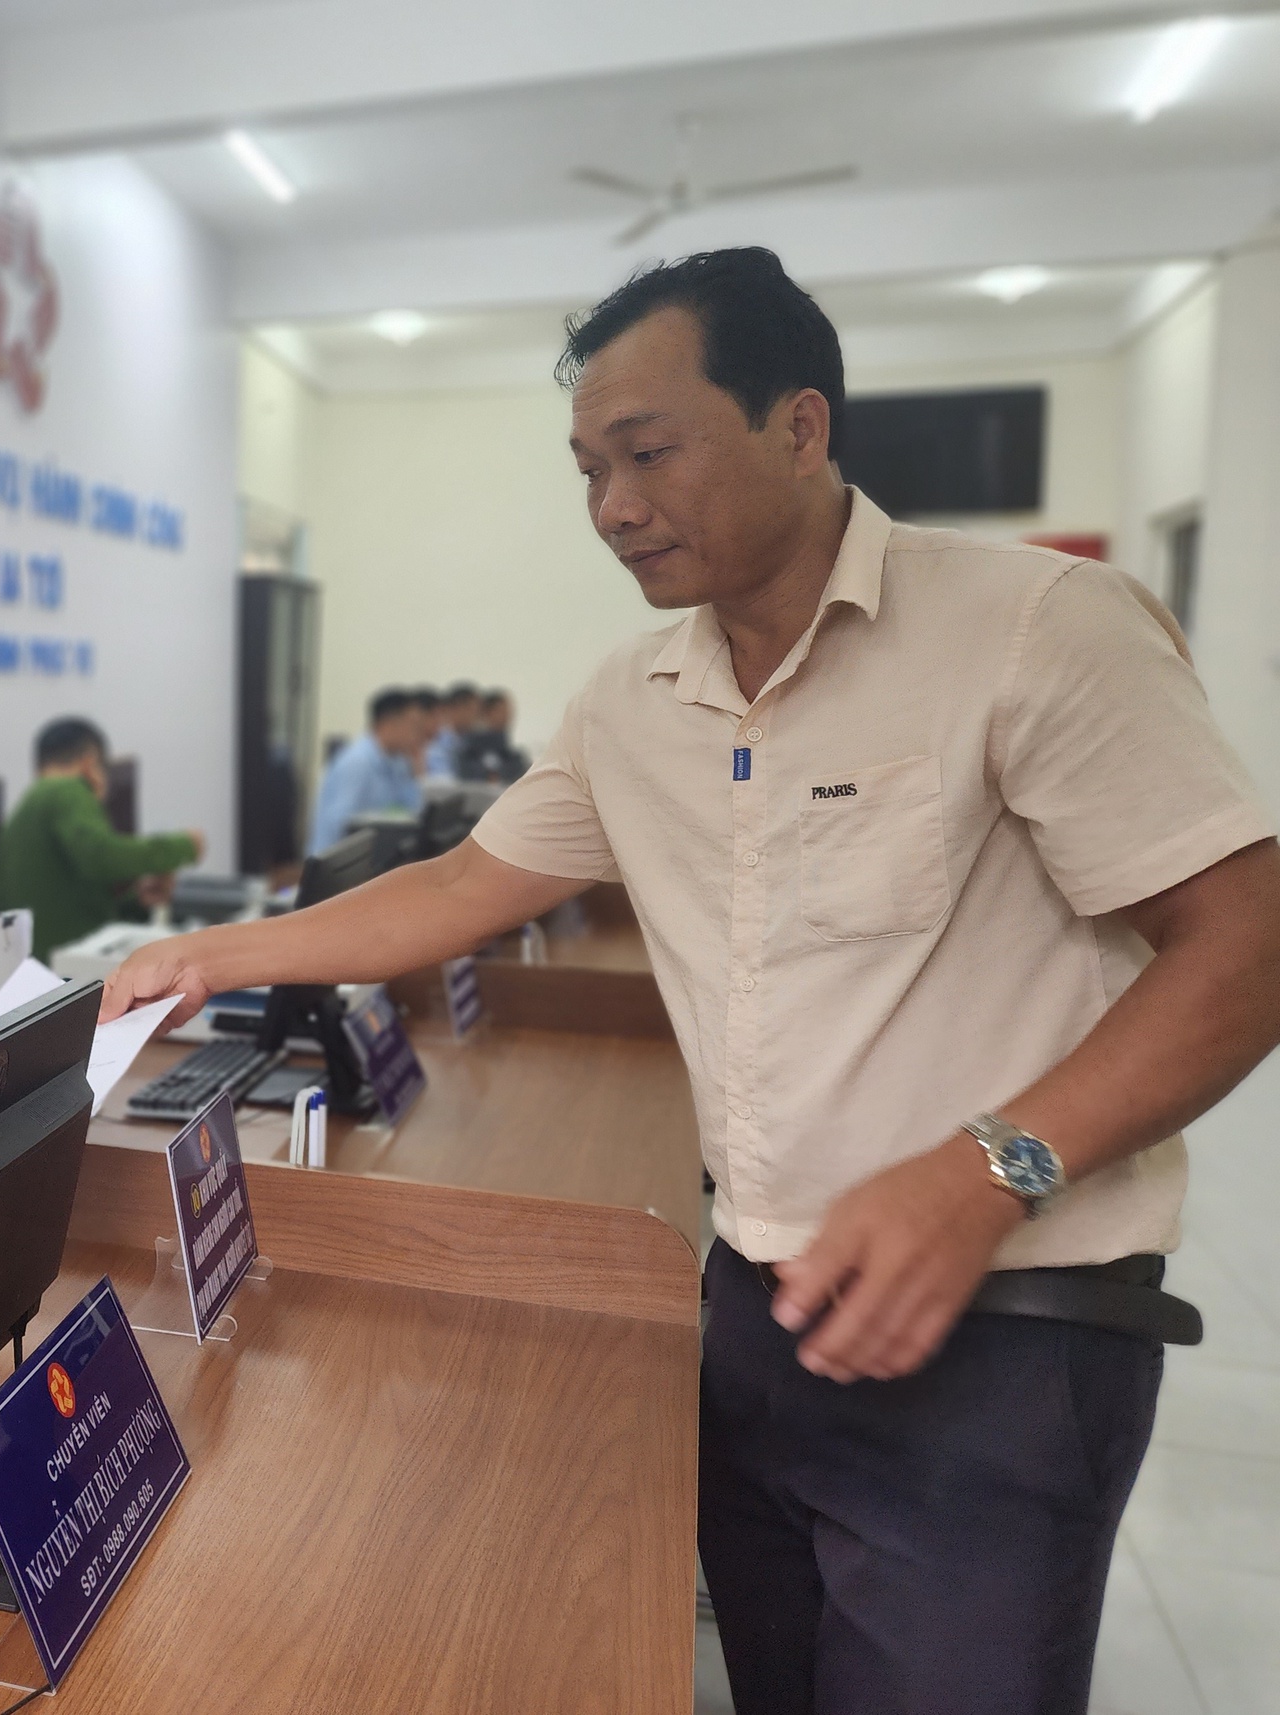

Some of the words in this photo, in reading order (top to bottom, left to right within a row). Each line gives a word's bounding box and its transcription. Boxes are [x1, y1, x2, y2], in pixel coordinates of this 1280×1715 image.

[811, 783, 858, 800] PRARIS
[46, 1422, 91, 1482] CHUYÊN
[85, 1390, 112, 1430] VIÊN
[25, 1500, 83, 1604] NGUYỄN
[73, 1480, 107, 1525] THỊ
[93, 1447, 127, 1508] BÍCH
[117, 1398, 162, 1474] PHƯỢNG
[80, 1556, 106, 1597] SĐT:
[102, 1478, 154, 1563] 0988.090.605
